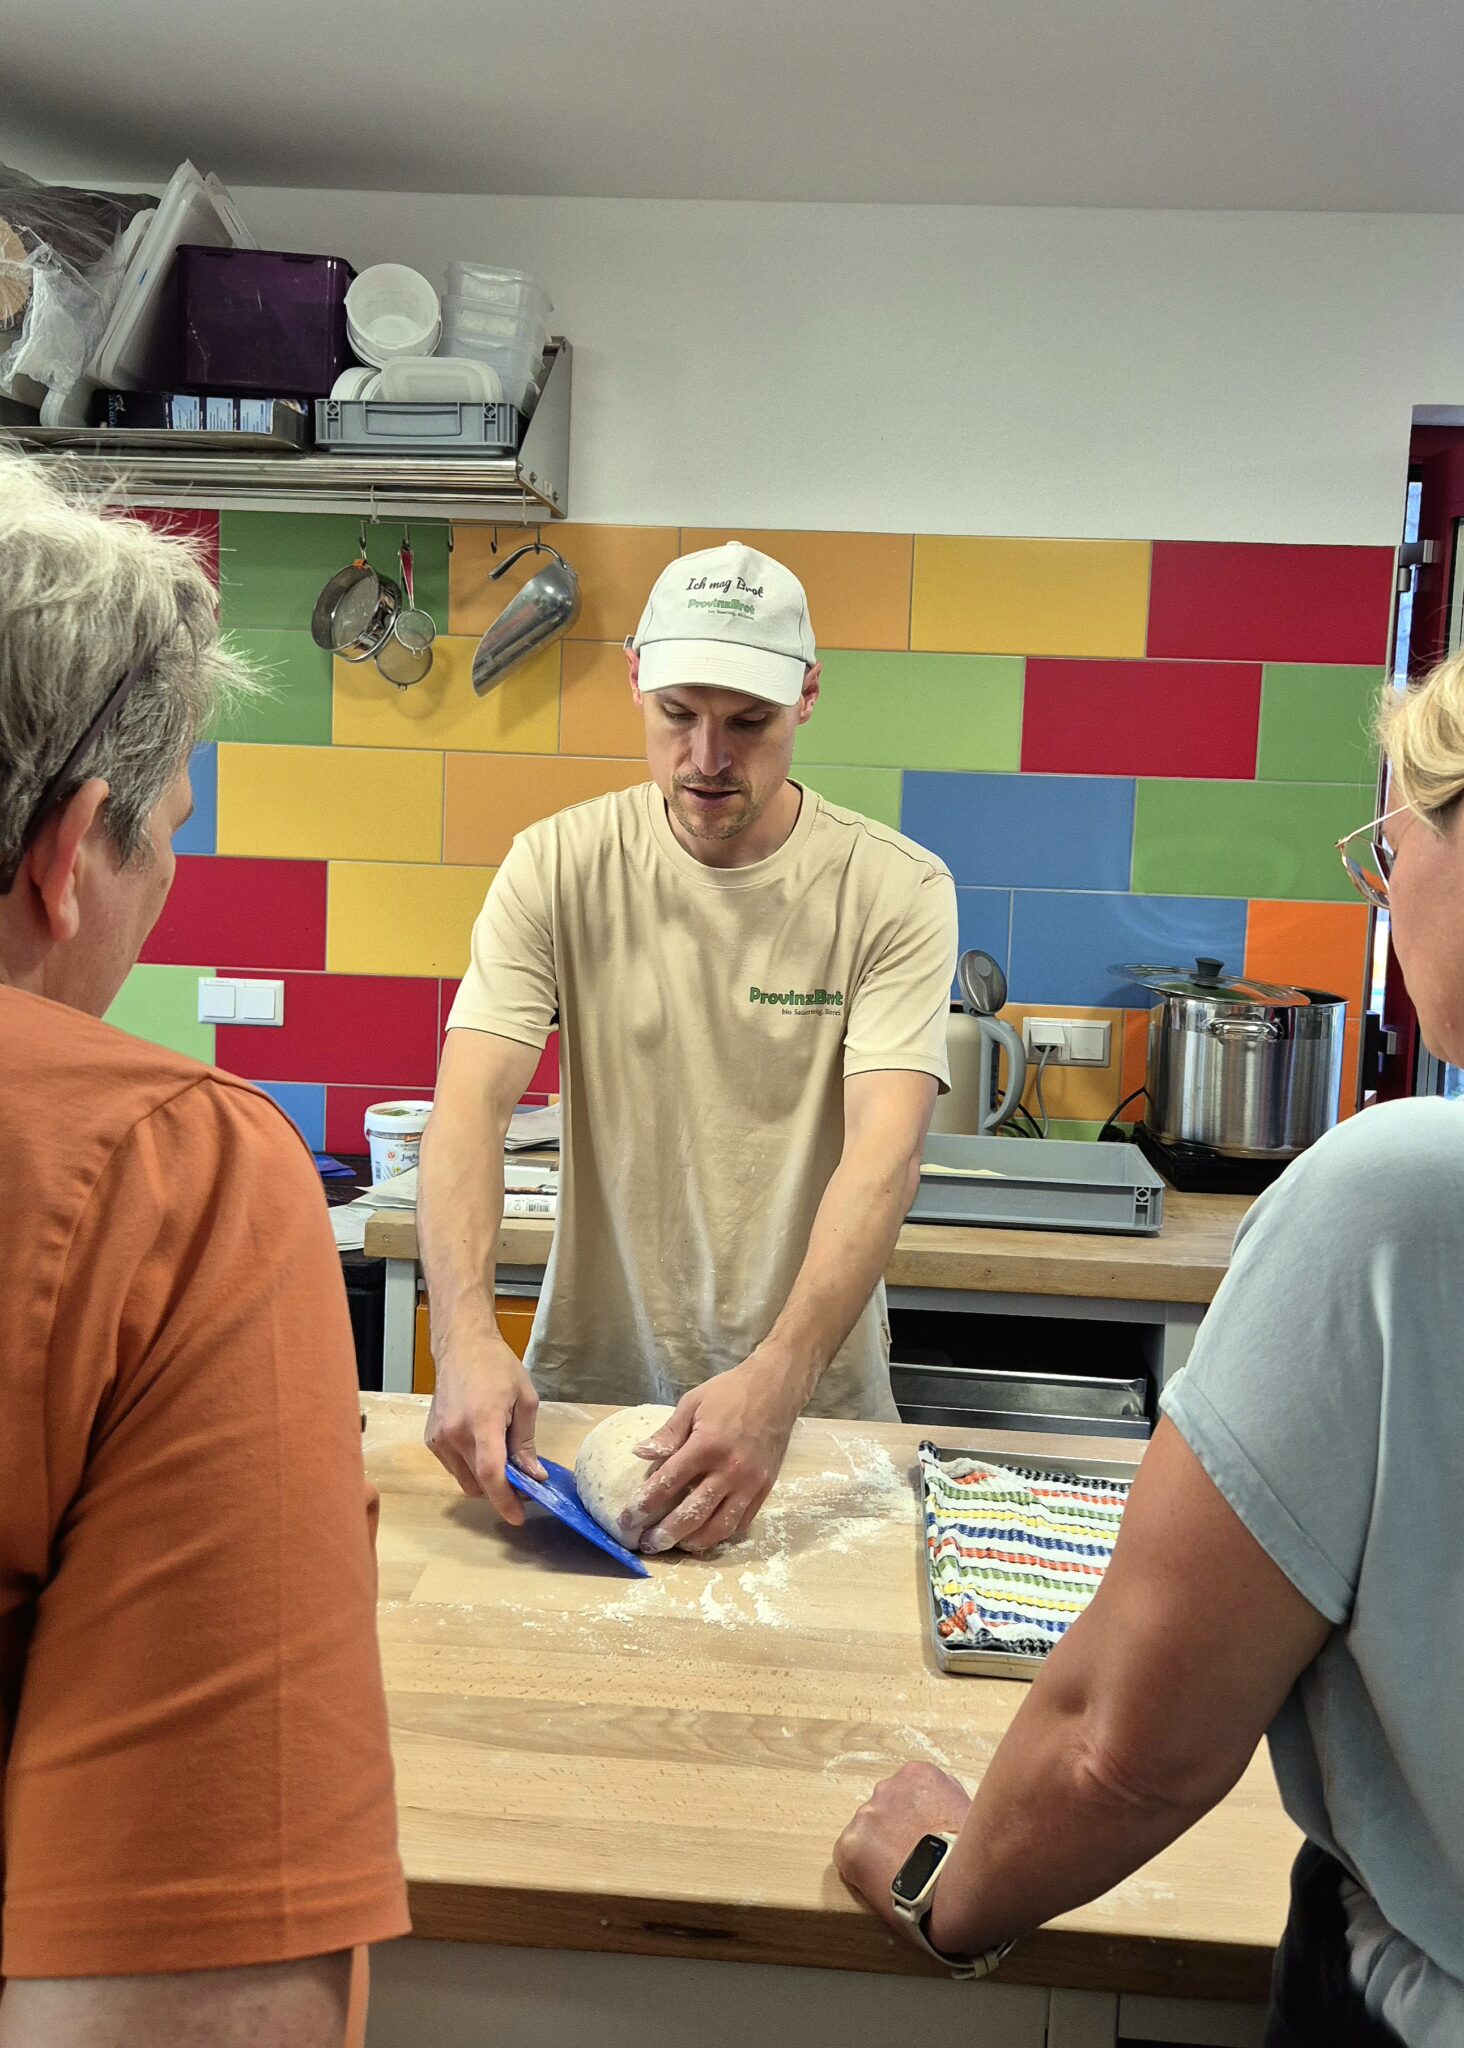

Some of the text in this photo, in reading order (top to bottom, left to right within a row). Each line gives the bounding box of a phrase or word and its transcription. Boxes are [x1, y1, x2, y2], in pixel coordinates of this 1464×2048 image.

[686, 577, 764, 598] Ich mag Brot
[400, 1153, 419, 1164] Jogh
